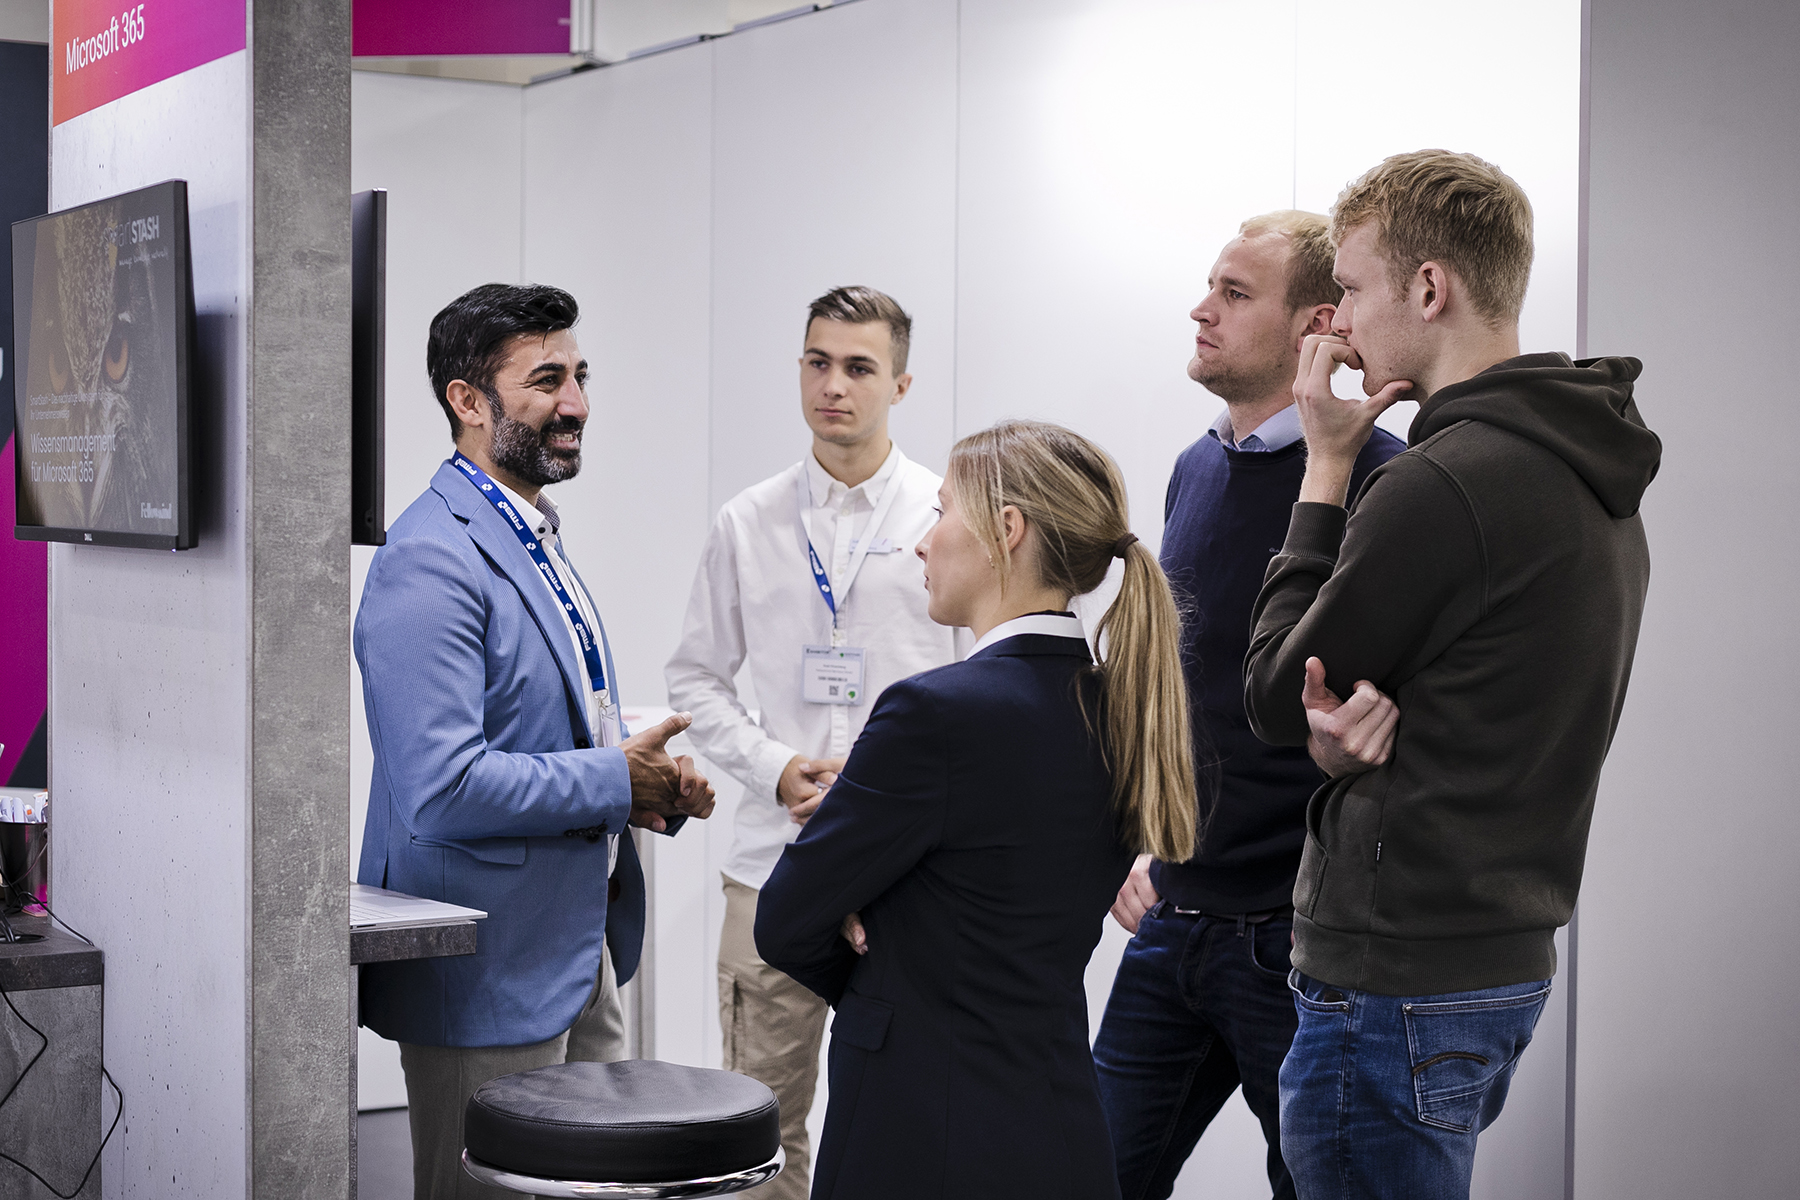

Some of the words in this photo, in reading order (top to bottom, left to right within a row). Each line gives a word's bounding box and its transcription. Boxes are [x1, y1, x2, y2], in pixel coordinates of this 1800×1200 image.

[66, 17, 120, 75] Microsoft
[121, 3, 145, 48] 365
[30, 432, 116, 459] Wissensmanagement
[31, 460, 41, 482] für
[43, 460, 77, 482] Microsoft
[78, 461, 94, 483] 365
